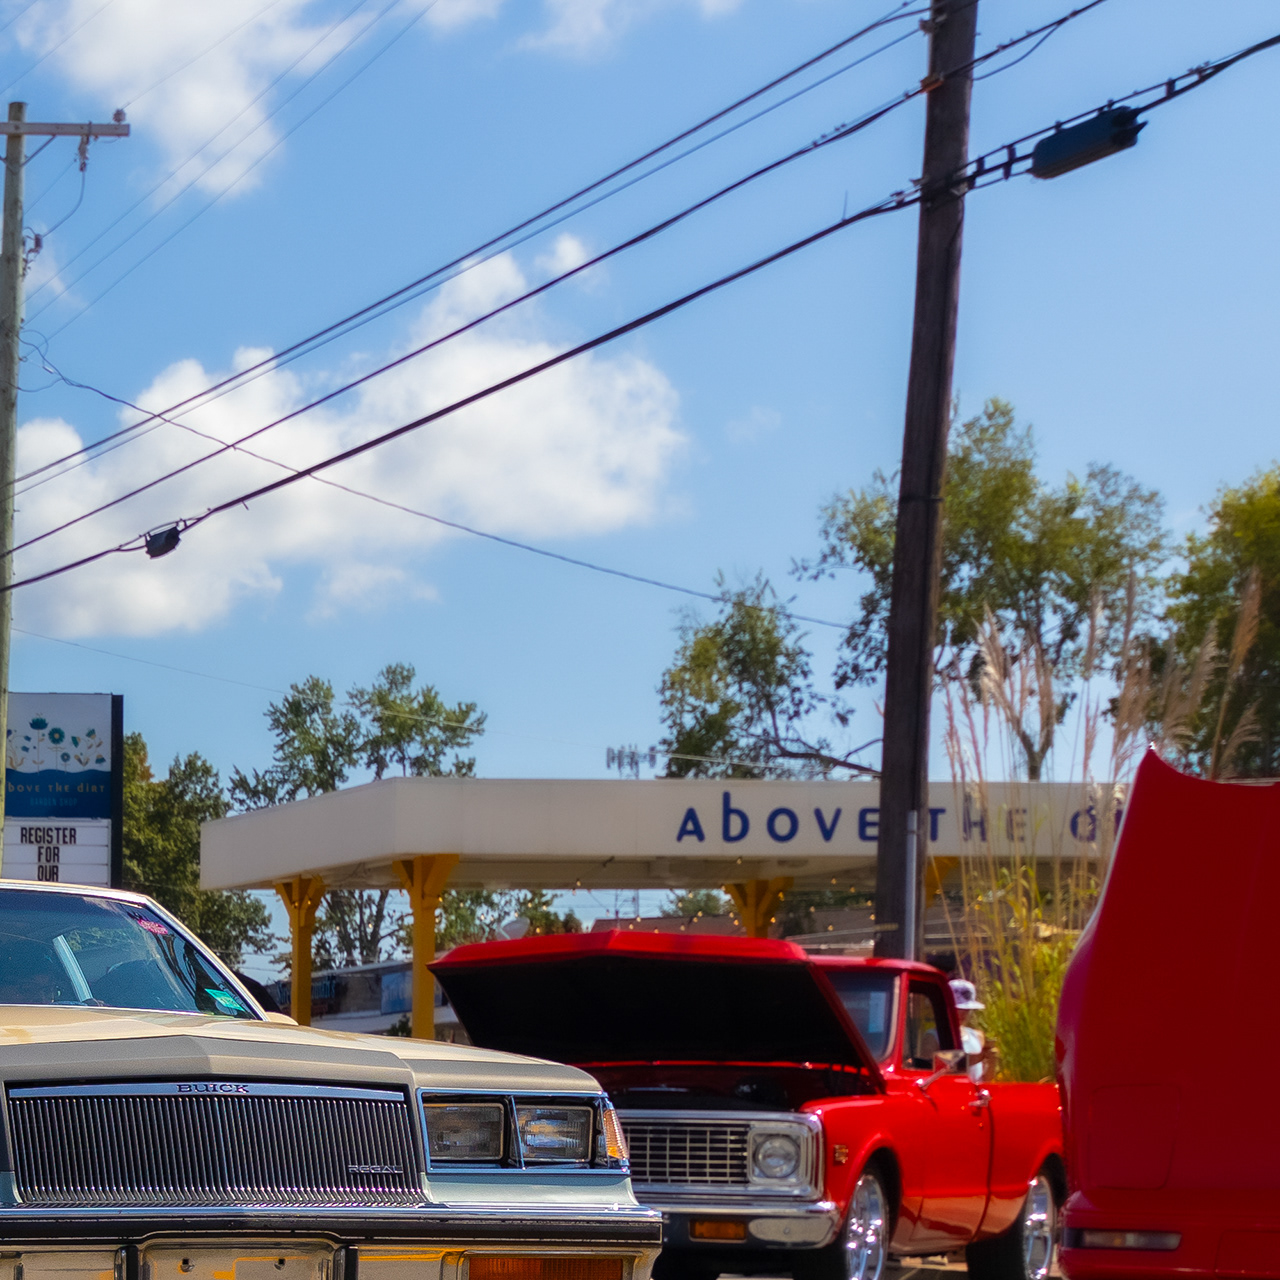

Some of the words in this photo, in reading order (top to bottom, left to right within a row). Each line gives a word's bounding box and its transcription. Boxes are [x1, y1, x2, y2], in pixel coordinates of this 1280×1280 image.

[21, 827, 77, 844] REGISTER
[37, 846, 60, 863] FOR
[37, 865, 59, 882] OUR
[176, 1083, 250, 1093] BUICK
[347, 1165, 404, 1174] REGAL
